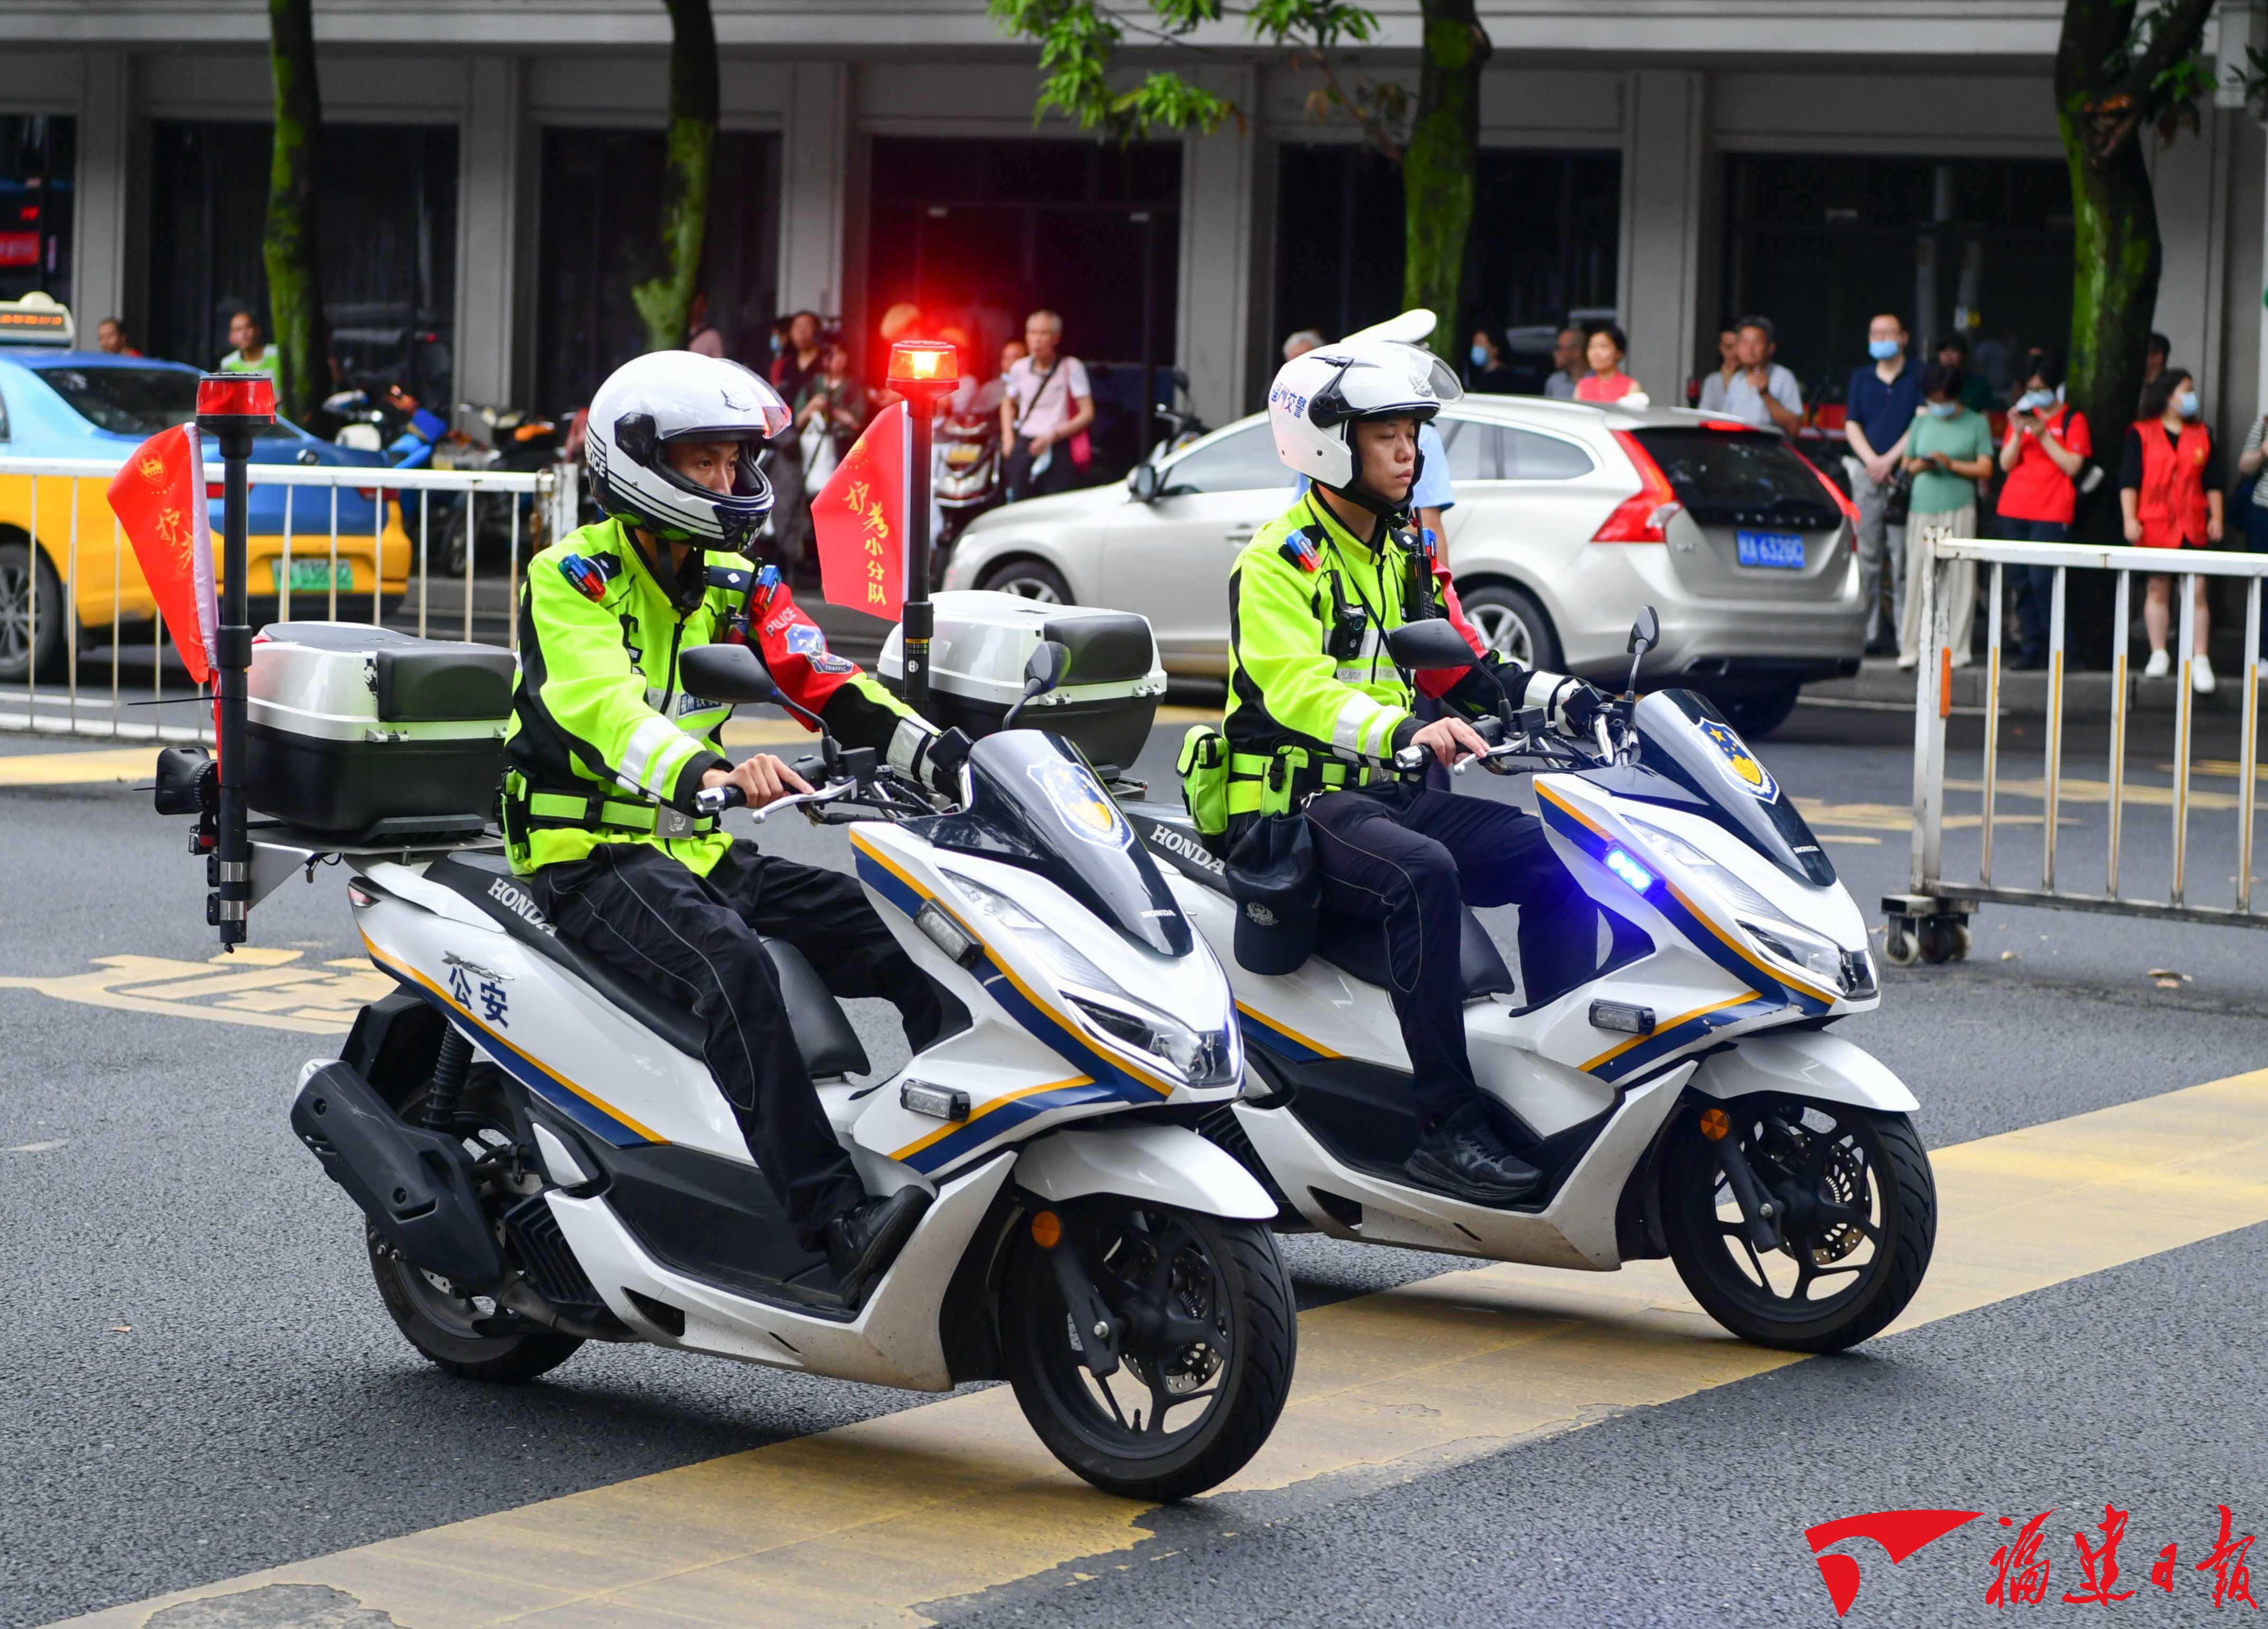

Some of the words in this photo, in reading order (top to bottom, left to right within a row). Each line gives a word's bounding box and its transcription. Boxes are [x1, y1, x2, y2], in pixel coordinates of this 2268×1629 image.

[568, 571, 588, 592] POLICE
[766, 607, 797, 637] POLICE
[1150, 823, 1226, 876] HONDA
[1793, 845, 1820, 854] HONDA
[487, 877, 558, 937] HONDA
[1140, 909, 1176, 918] HONDA
[449, 967, 509, 1029] 公安
